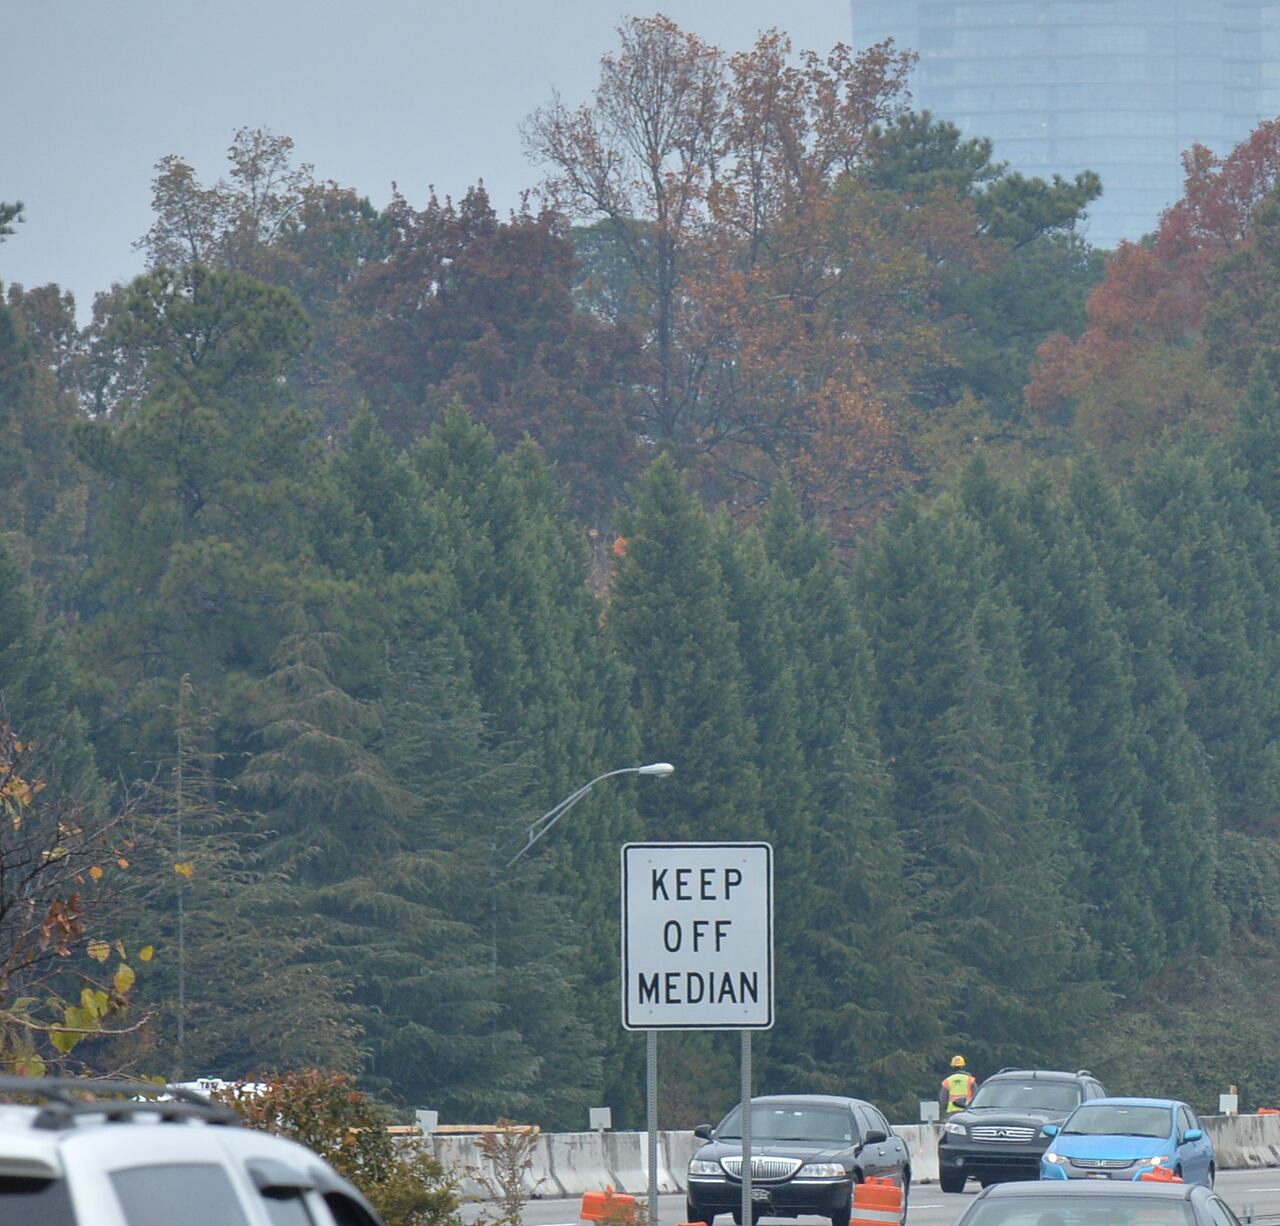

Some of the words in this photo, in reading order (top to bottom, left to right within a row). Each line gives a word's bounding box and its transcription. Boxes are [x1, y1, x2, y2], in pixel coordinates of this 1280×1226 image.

[651, 868, 742, 901] KEEP
[663, 919, 732, 952] OFF
[638, 971, 758, 1004] MEDIAN
